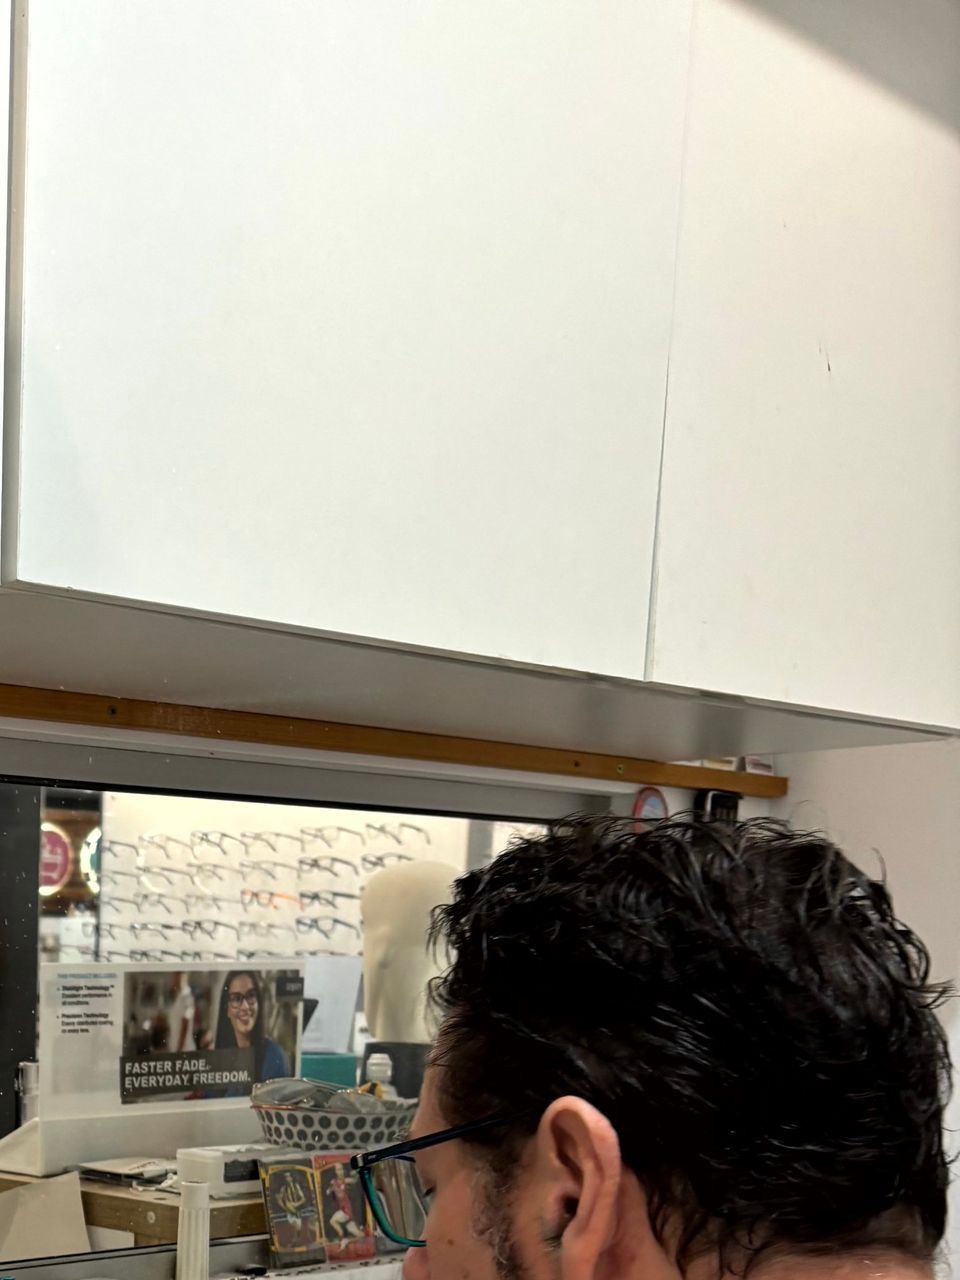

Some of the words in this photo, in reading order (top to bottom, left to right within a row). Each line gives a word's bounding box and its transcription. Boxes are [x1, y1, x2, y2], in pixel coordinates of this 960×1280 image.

[125, 1061, 172, 1074] FASTER
[175, 1059, 209, 1072] FADE.
[124, 1074, 190, 1089] EVERYDAY
[193, 1070, 251, 1085] FREEDOM.
